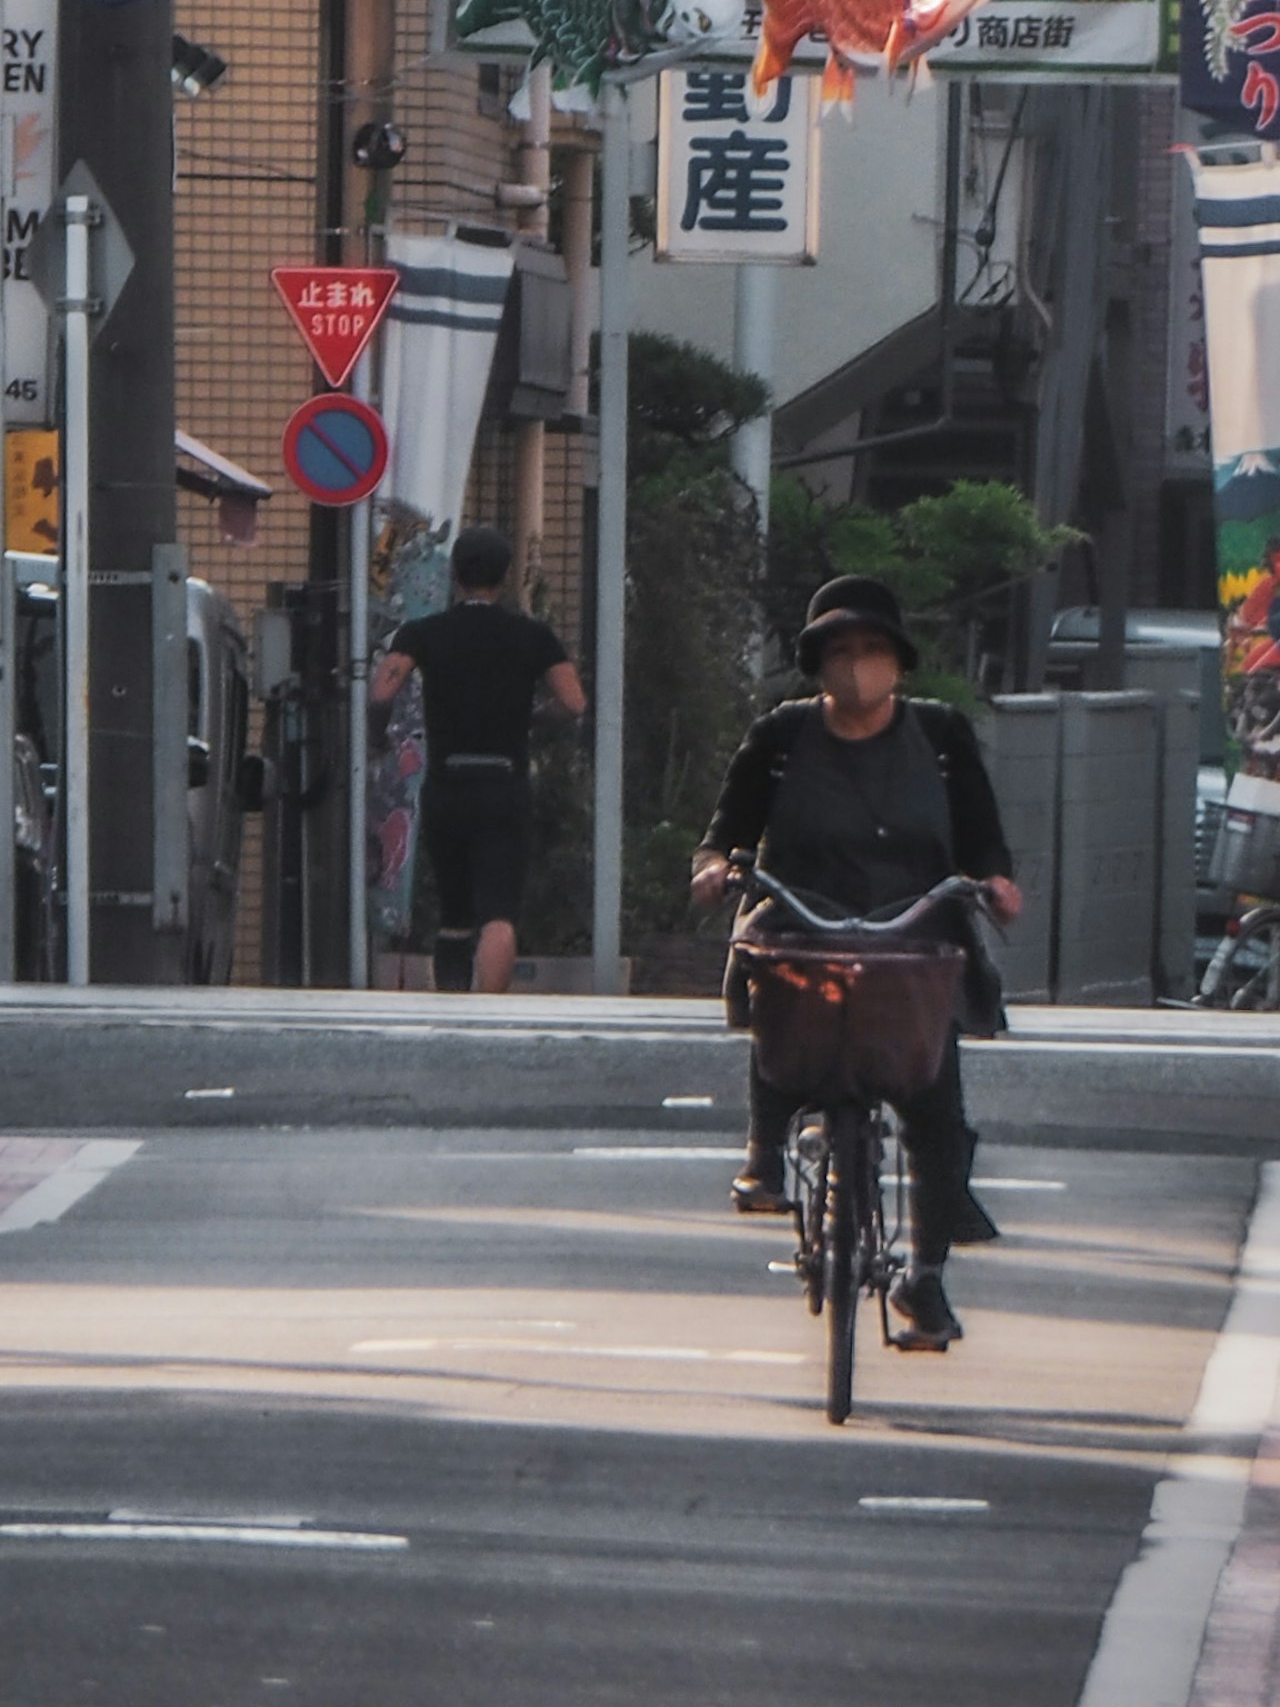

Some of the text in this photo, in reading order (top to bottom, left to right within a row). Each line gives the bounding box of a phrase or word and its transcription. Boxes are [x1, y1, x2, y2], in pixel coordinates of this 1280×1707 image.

[297, 281, 375, 308] 止まれ
[311, 314, 365, 336] STOP
